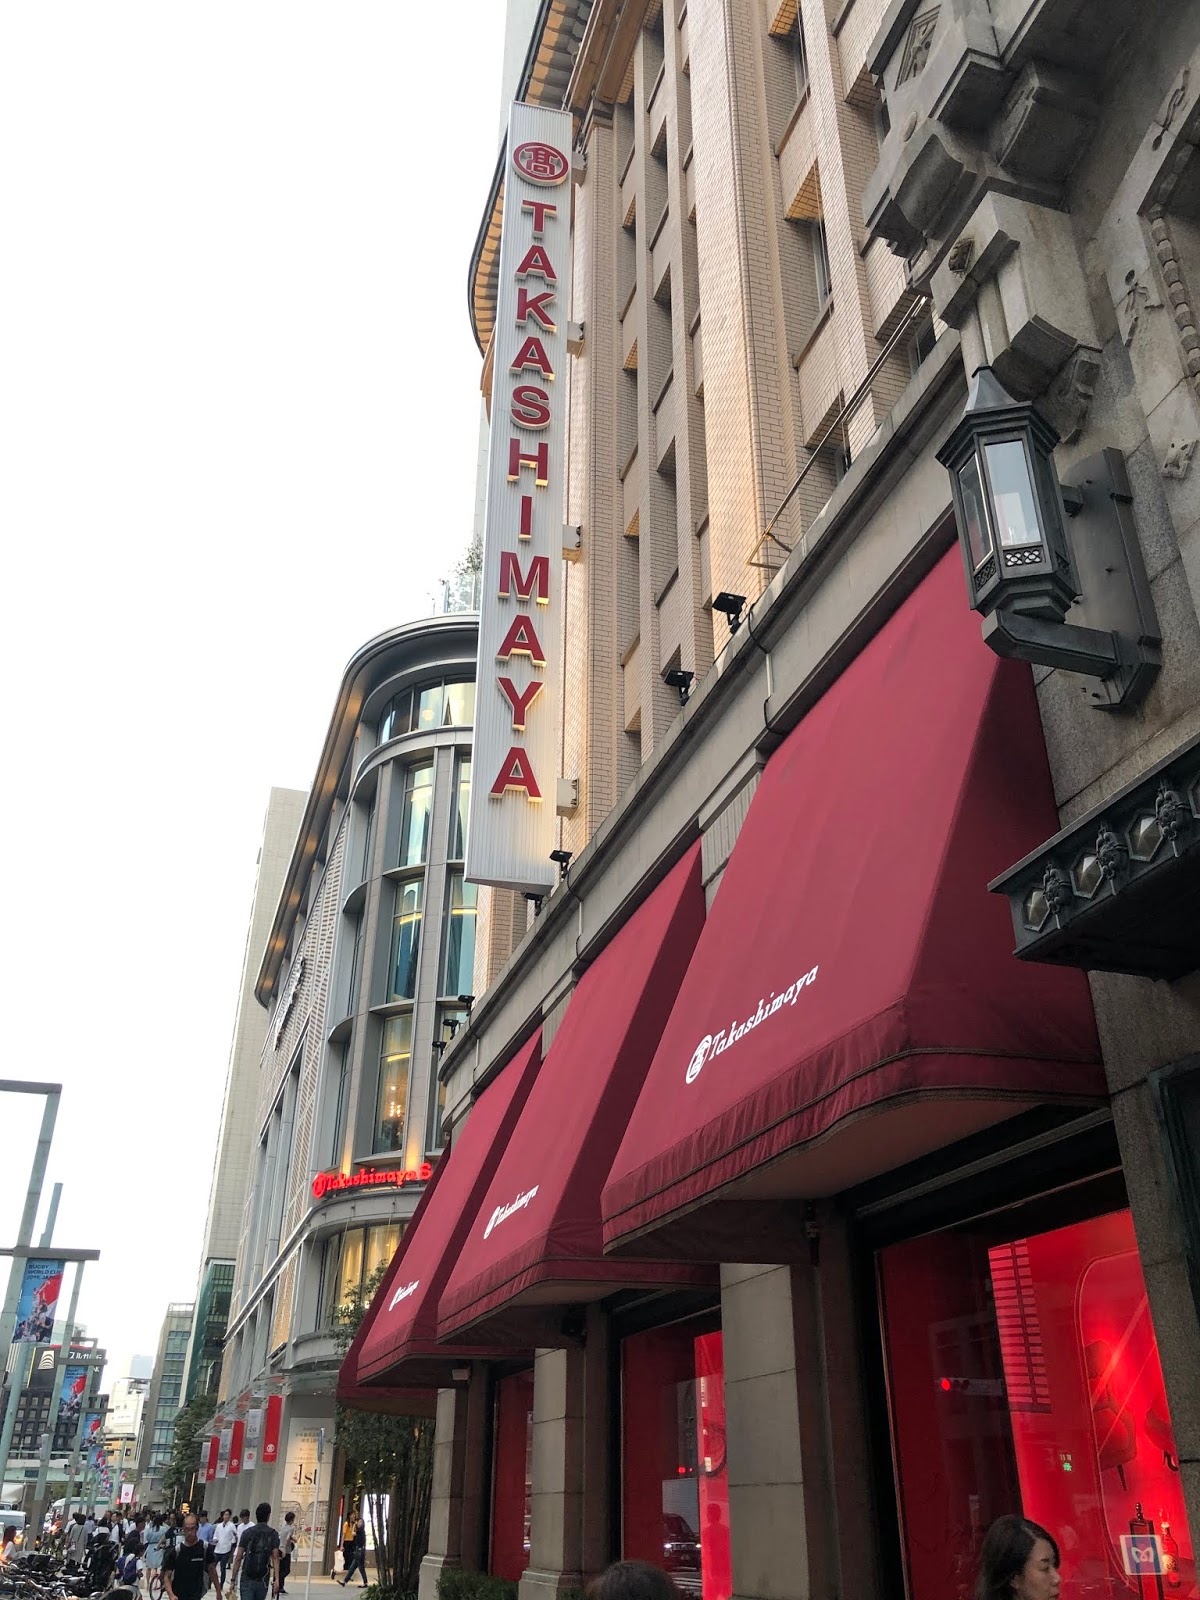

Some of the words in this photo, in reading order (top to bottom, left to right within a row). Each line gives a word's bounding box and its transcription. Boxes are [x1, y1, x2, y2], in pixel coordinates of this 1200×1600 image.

[489, 199, 558, 803] TAKASHIMAYA
[708, 965, 819, 1061] Takashimaya
[326, 1168, 418, 1191] Takashimaya
